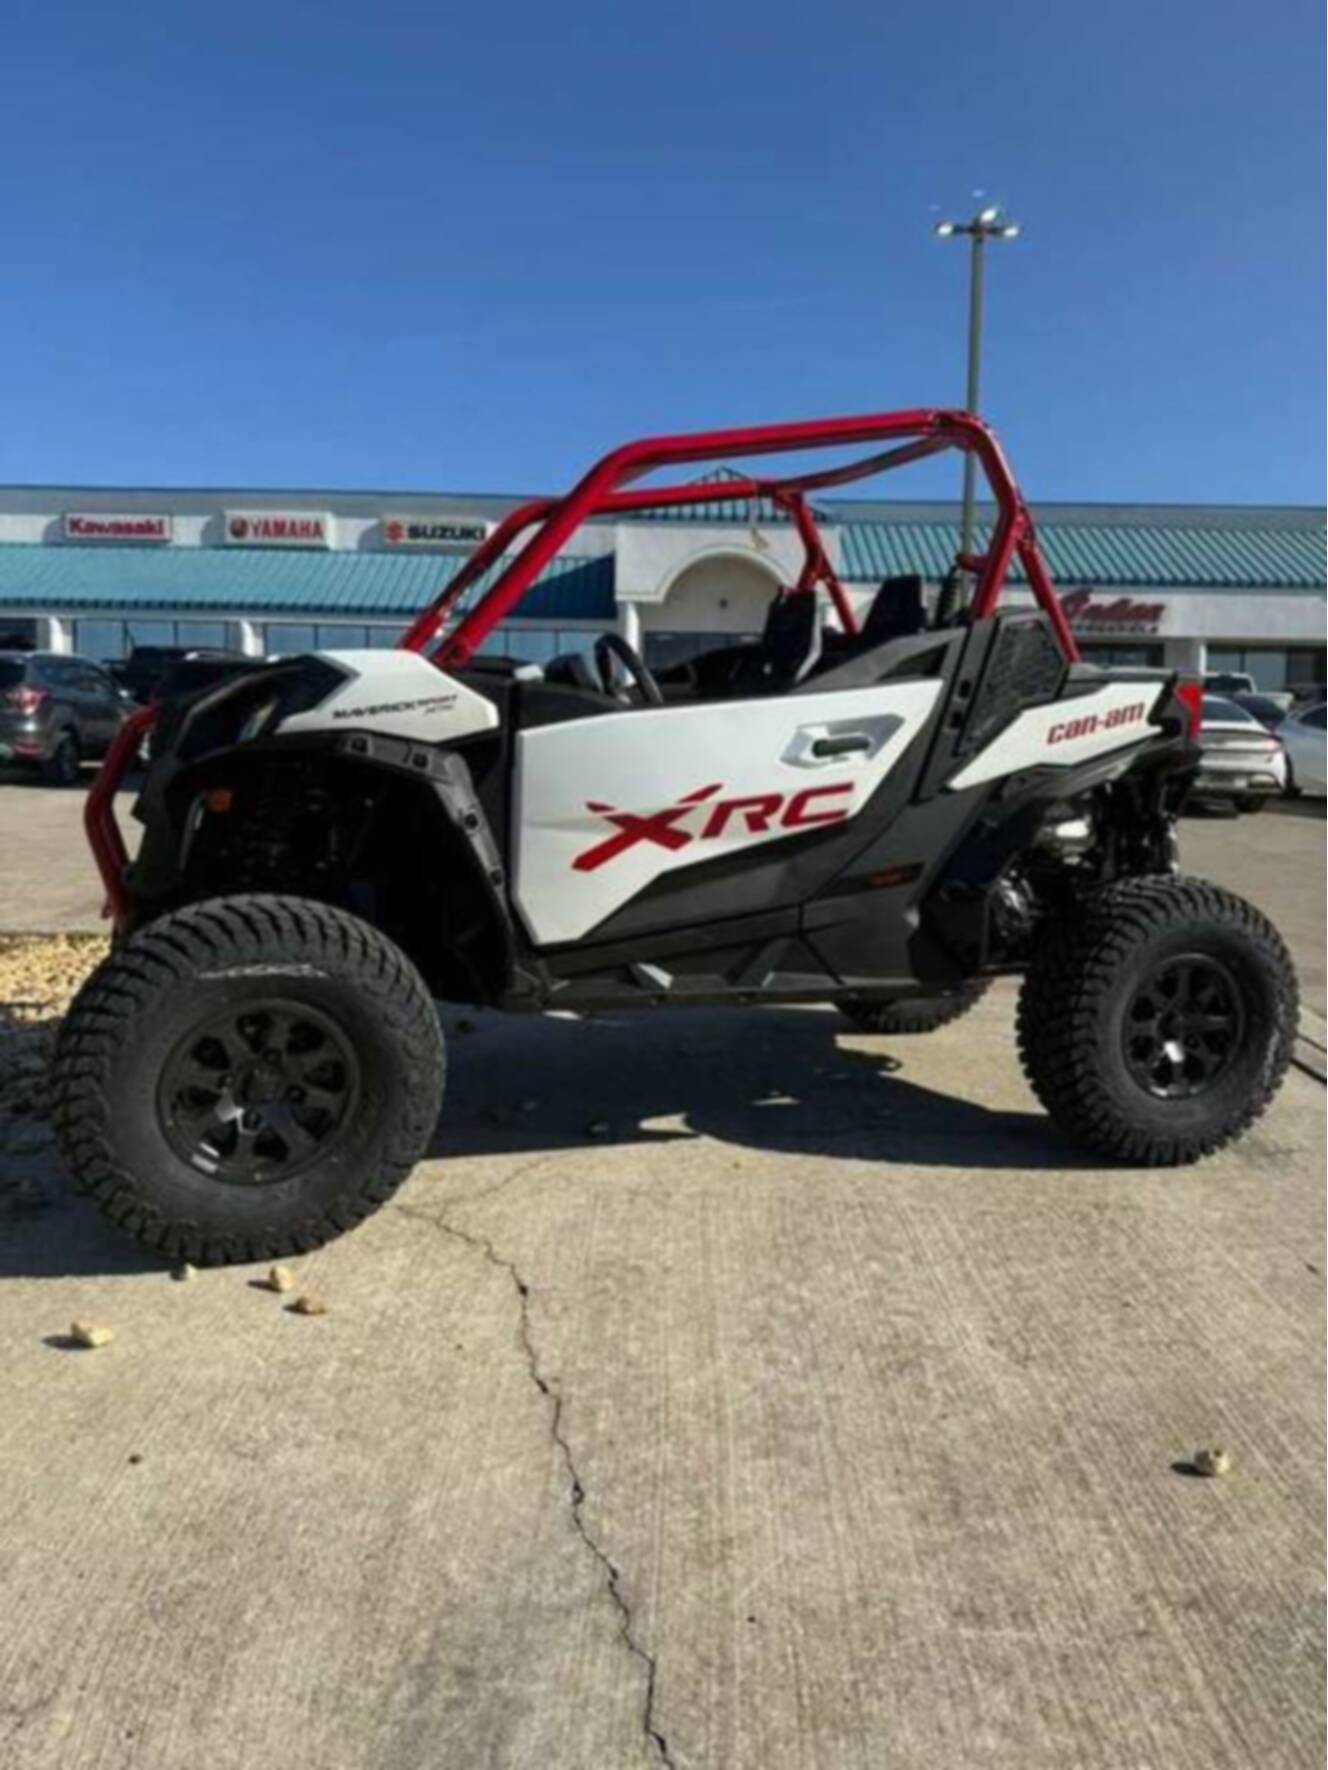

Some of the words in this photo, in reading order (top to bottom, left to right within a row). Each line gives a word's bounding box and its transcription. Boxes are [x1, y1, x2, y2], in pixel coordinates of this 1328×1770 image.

[69, 517, 164, 536] Kawasaki
[248, 518, 325, 538] YAMAHA
[408, 525, 487, 540] SUZUKI
[1046, 702, 1146, 746] can-am
[571, 782, 855, 872] XRC
